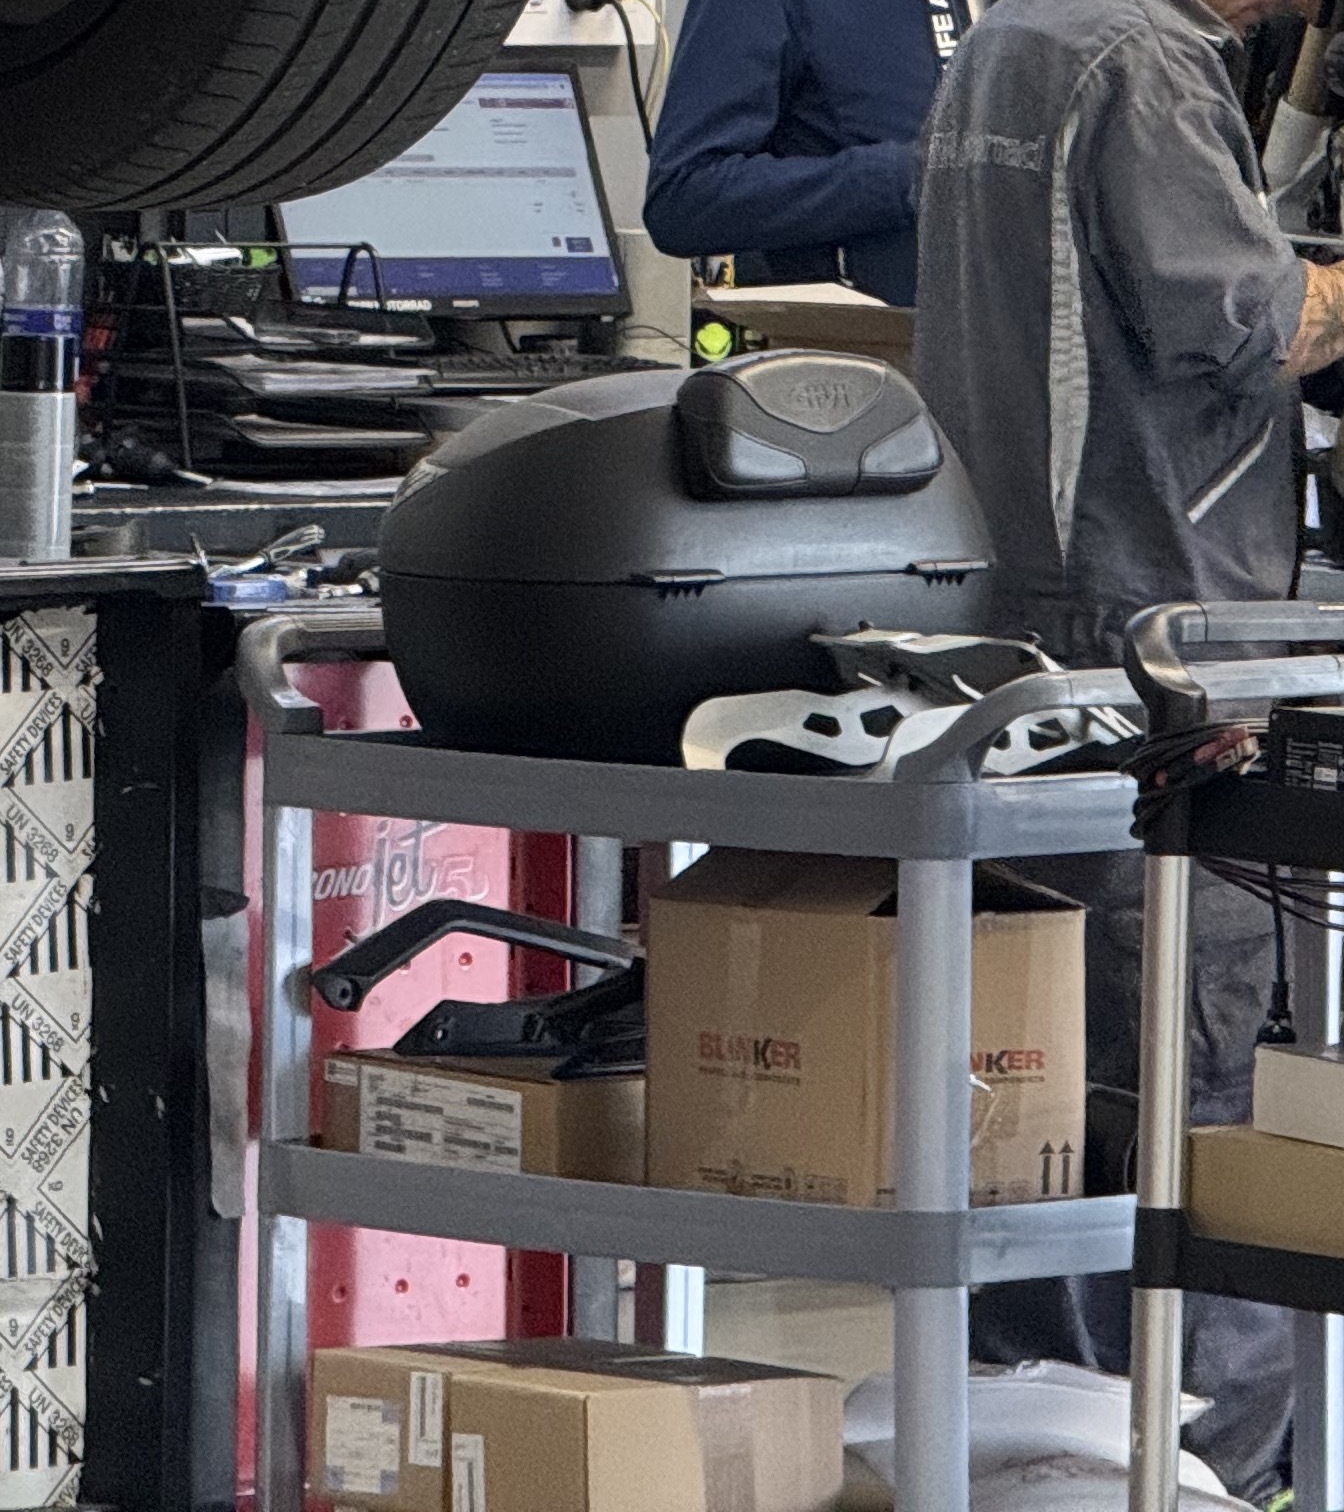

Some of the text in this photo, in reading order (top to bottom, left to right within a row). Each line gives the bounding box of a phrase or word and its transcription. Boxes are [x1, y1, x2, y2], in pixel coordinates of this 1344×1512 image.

[21, 639, 54, 678] 3268
[26, 690, 65, 736] DEVICES
[6, 803, 60, 864] UN 3268
[3, 880, 68, 965] SAFETY DEVICES
[11, 992, 65, 1053] UN 3268
[20, 1119, 52, 1167] SAFETY
[32, 1105, 84, 1174] UN 3268
[24, 1310, 58, 1354] SAFETY
[29, 1387, 52, 1415] UN
[48, 1409, 80, 1448] 3268
